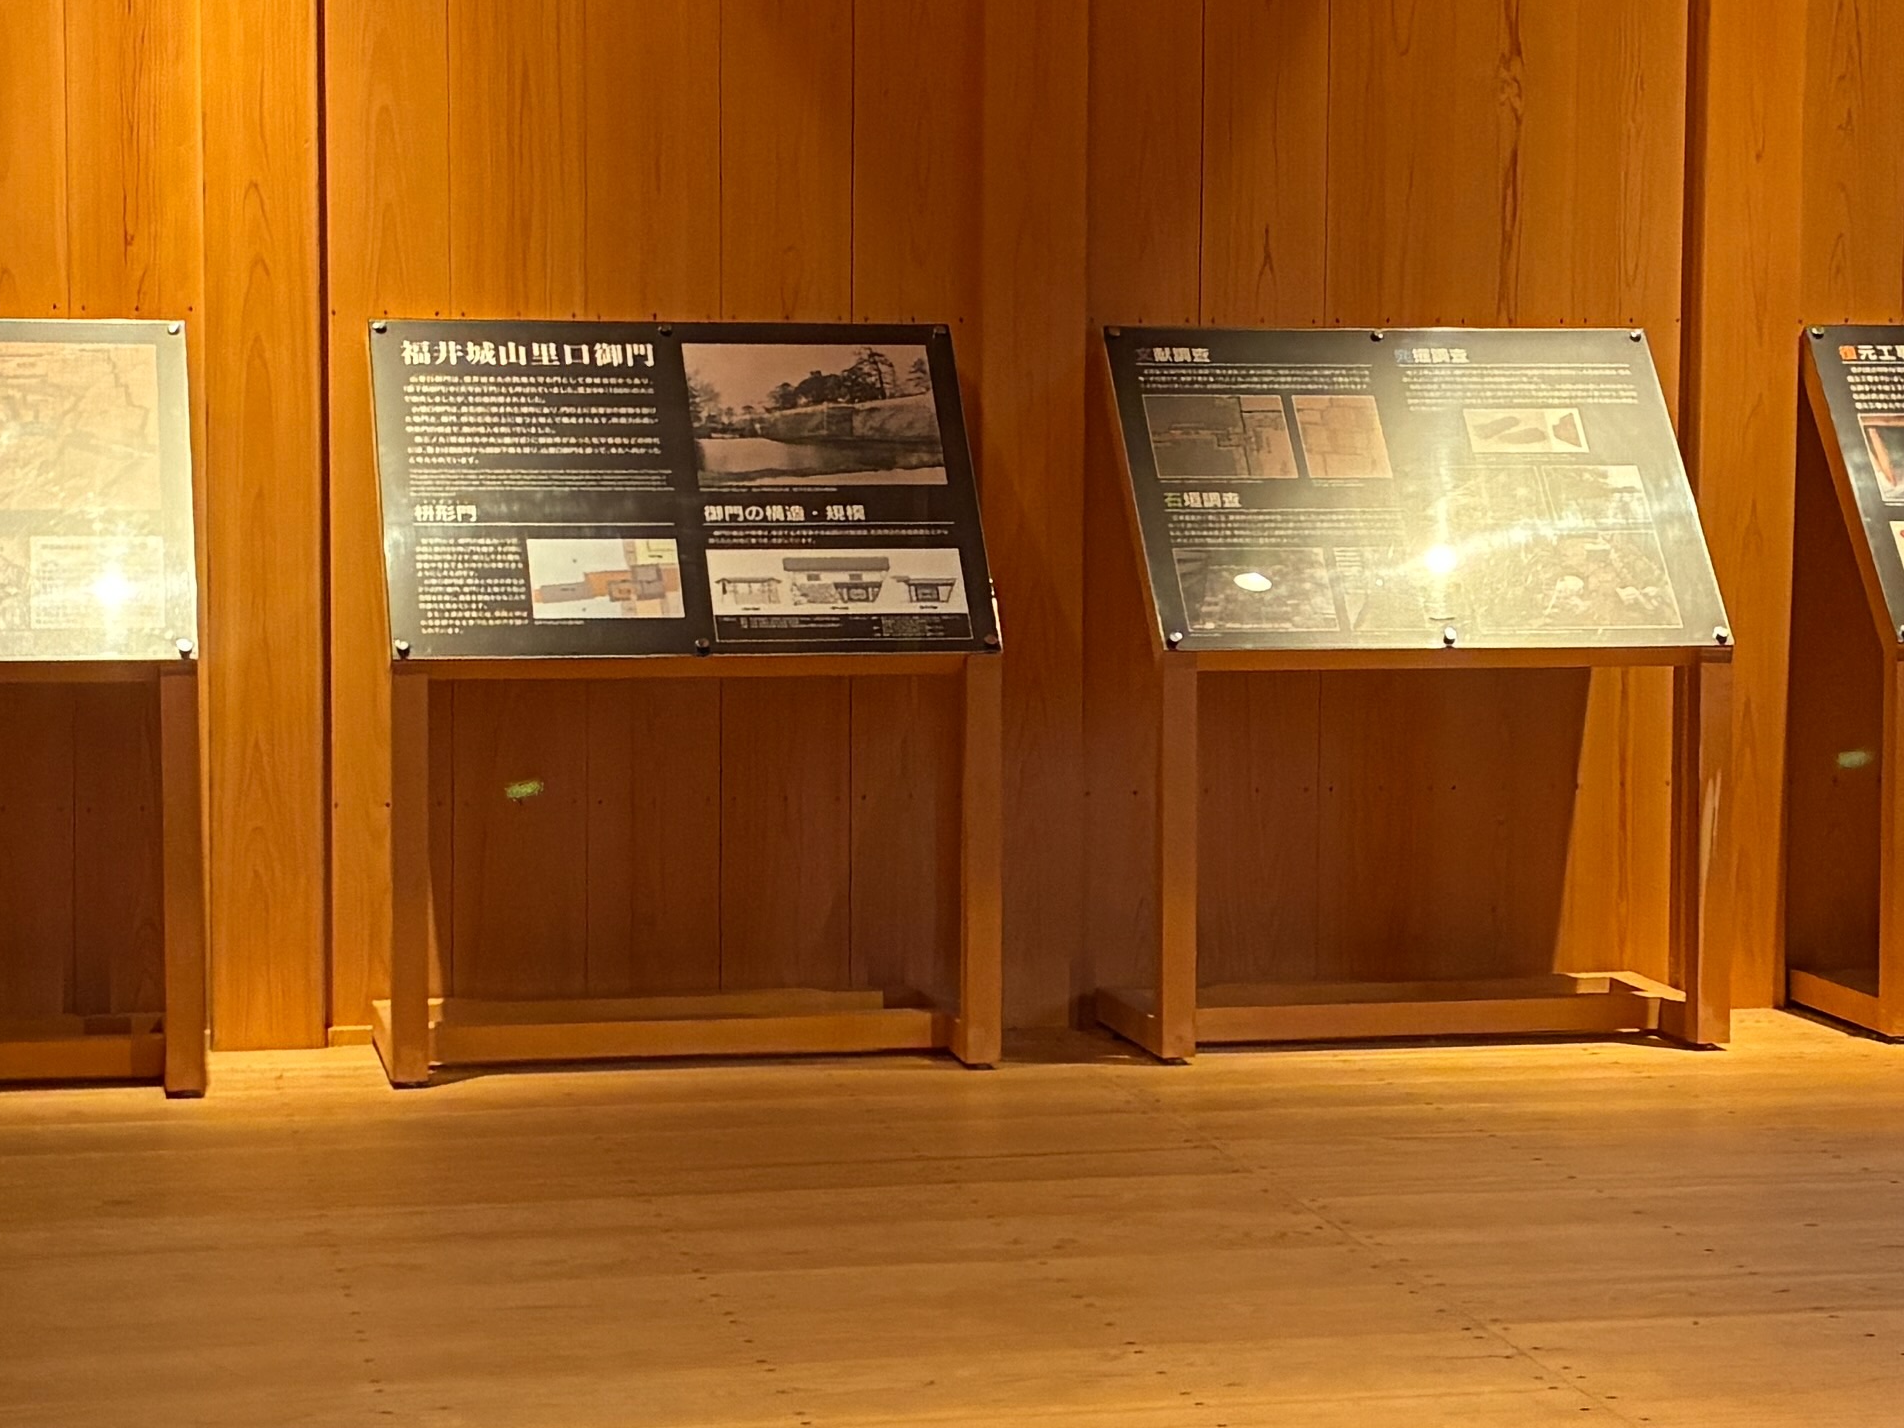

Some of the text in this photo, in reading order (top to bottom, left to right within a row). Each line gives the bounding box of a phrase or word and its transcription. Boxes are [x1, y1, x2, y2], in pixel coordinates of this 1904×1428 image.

[401, 341, 655, 367] 福井城山里口御門
